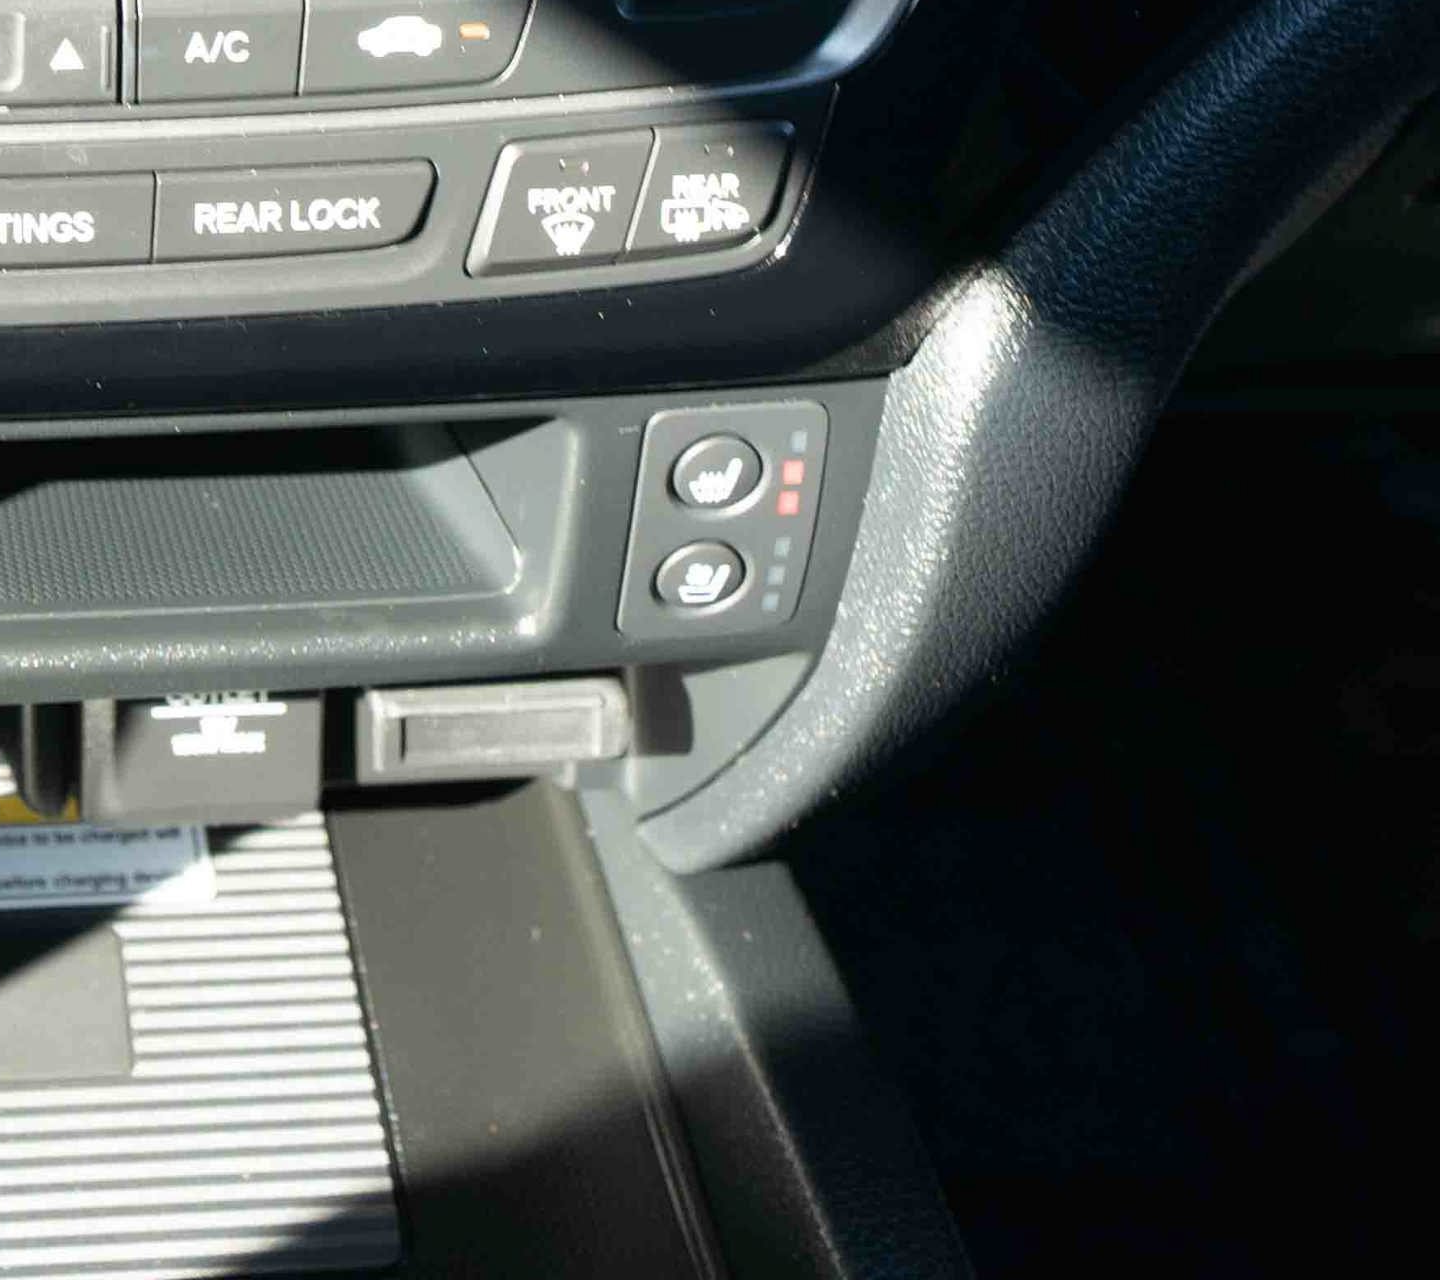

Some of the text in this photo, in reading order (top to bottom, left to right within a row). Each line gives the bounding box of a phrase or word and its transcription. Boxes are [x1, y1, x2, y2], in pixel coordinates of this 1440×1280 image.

[184, 31, 250, 63] A/C
[527, 185, 616, 216] FRONT
[673, 173, 740, 202] REAR
[193, 196, 381, 235] REAR LOCK
